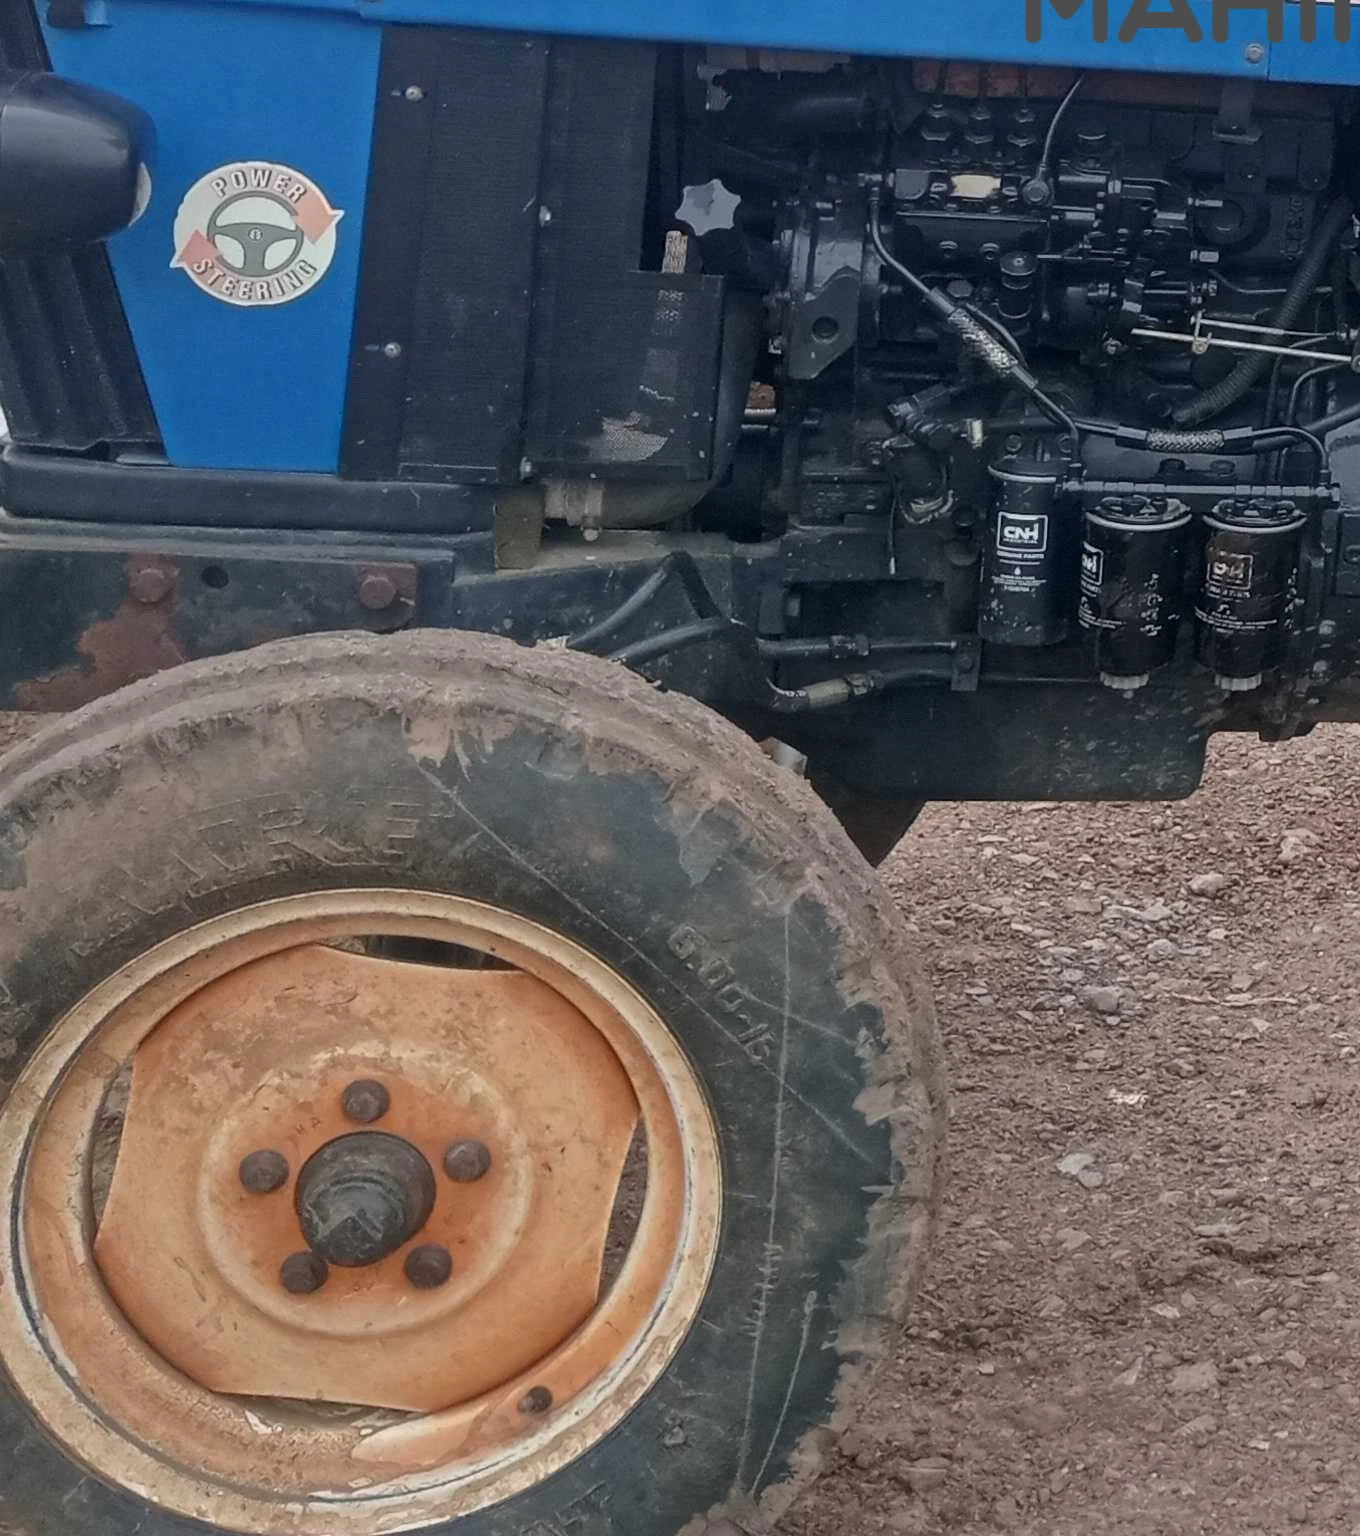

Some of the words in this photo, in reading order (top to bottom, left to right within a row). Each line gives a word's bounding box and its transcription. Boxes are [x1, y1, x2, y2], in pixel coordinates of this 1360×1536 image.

[211, 167, 308, 204] POWER
[193, 257, 318, 300] STEERING
[1003, 522, 1040, 541] CNH
